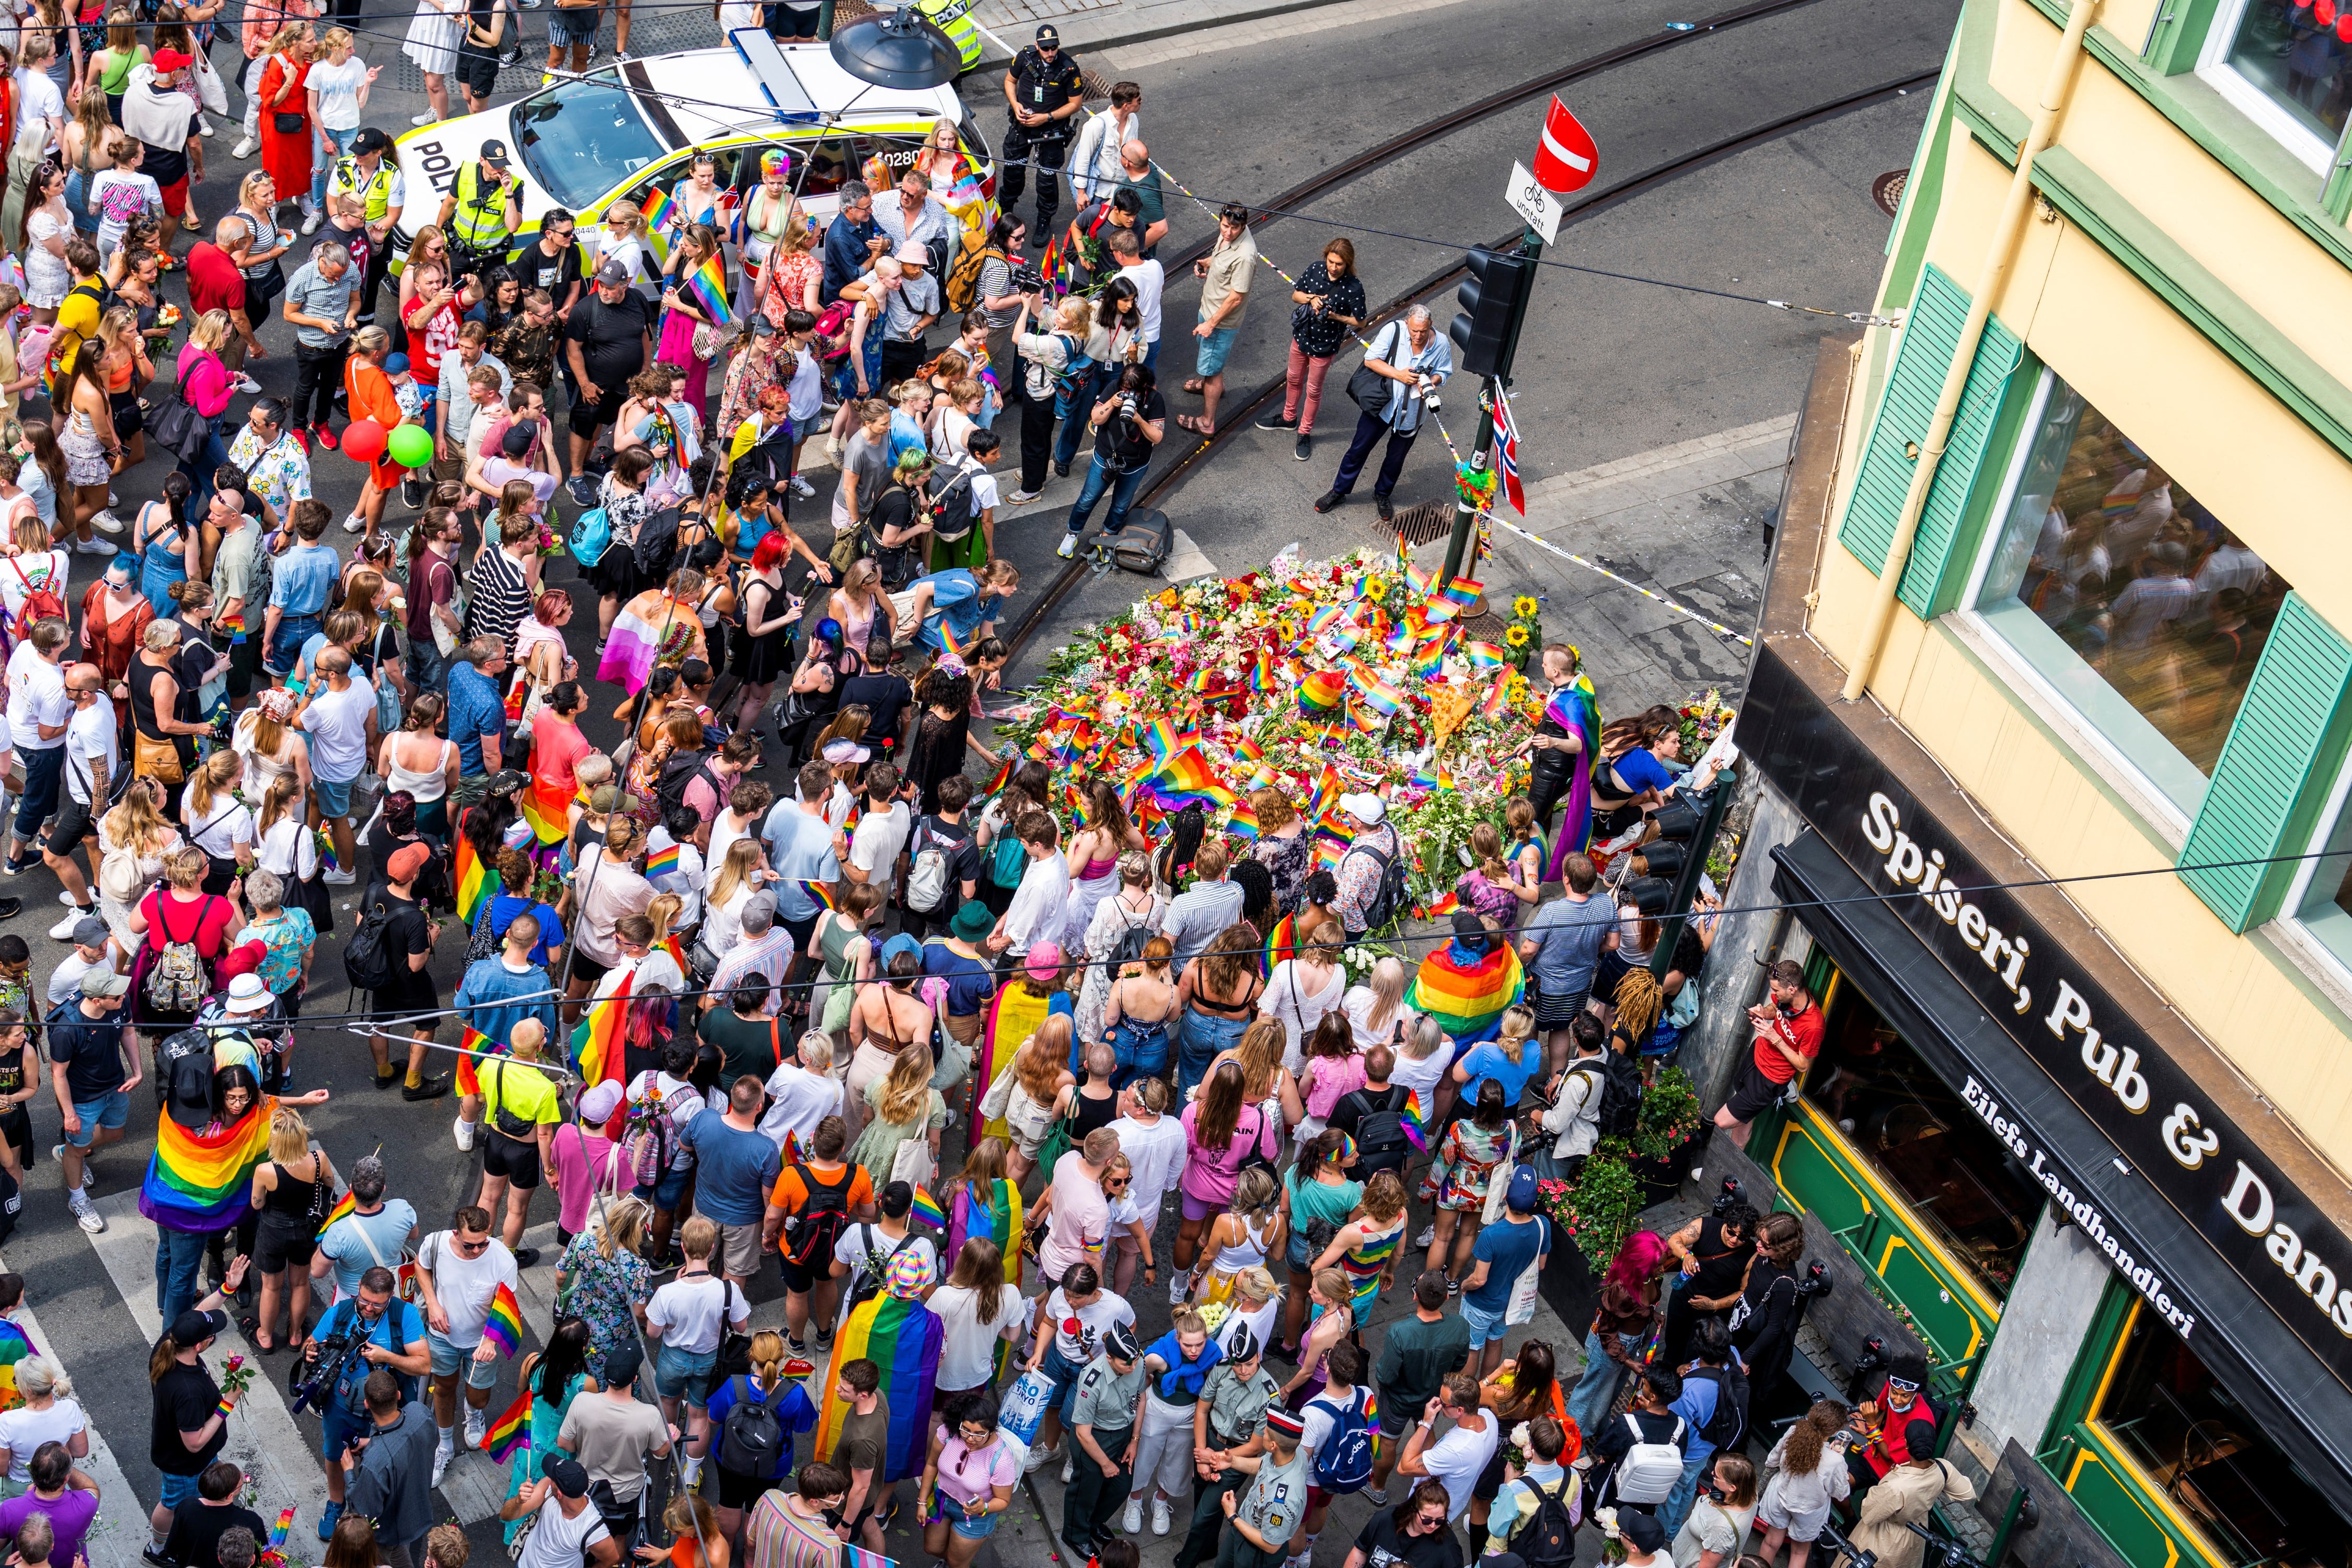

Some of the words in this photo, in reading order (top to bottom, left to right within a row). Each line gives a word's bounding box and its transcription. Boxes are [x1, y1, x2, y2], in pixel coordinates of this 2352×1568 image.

[320, 80, 337, 95] NEW
[1517, 199, 1544, 231] unntatt
[575, 226, 595, 235] 0440
[1862, 792, 2031, 1014] Spiseri,
[2045, 979, 2150, 1114] Pub
[2162, 1102, 2219, 1170] &
[1780, 1019, 1797, 1045] BACK.
[1961, 1075, 2028, 1158] Eilefs
[2029, 1149, 2195, 1339] Landhandleri
